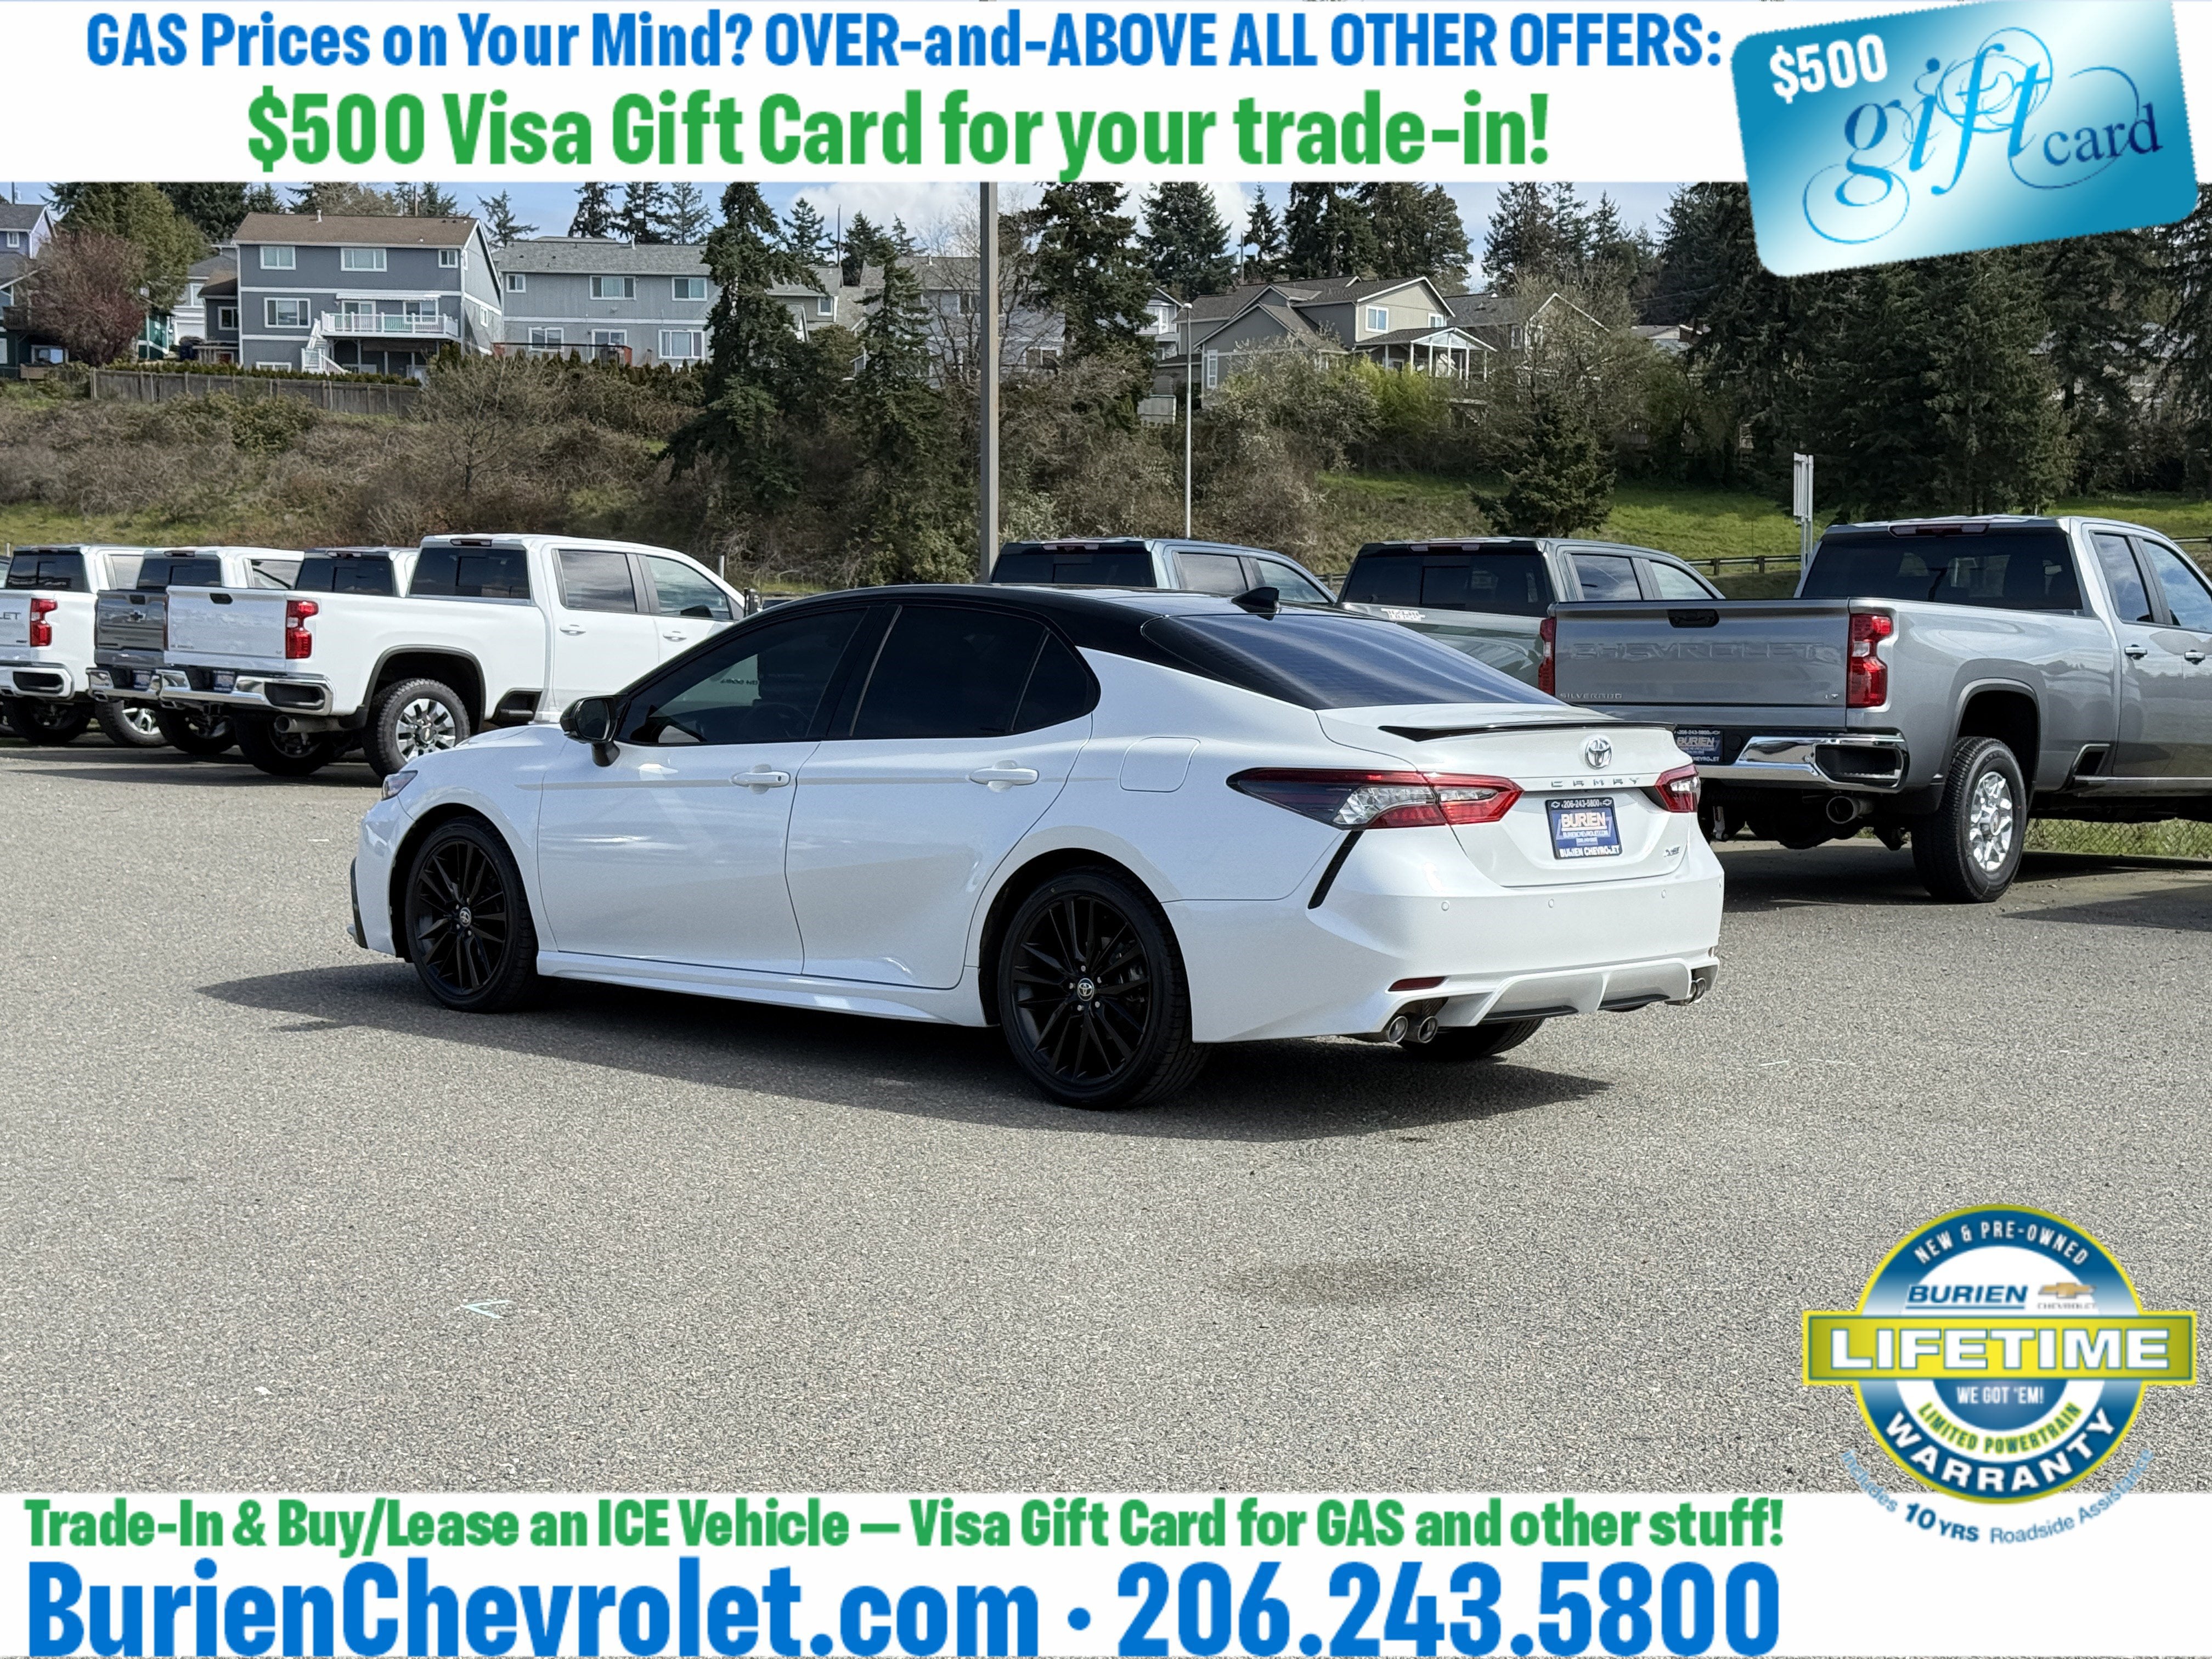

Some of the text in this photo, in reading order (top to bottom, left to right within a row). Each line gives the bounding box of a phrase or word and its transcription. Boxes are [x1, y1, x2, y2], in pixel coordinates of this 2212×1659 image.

[1572, 642, 1824, 659] CHEVROLET
[1677, 737, 1715, 746] BURIEN
[1551, 777, 1640, 788] CAMRY
[1561, 811, 1606, 828] BURIEN
[1559, 844, 1620, 858] BURIEN CHEVROLET
